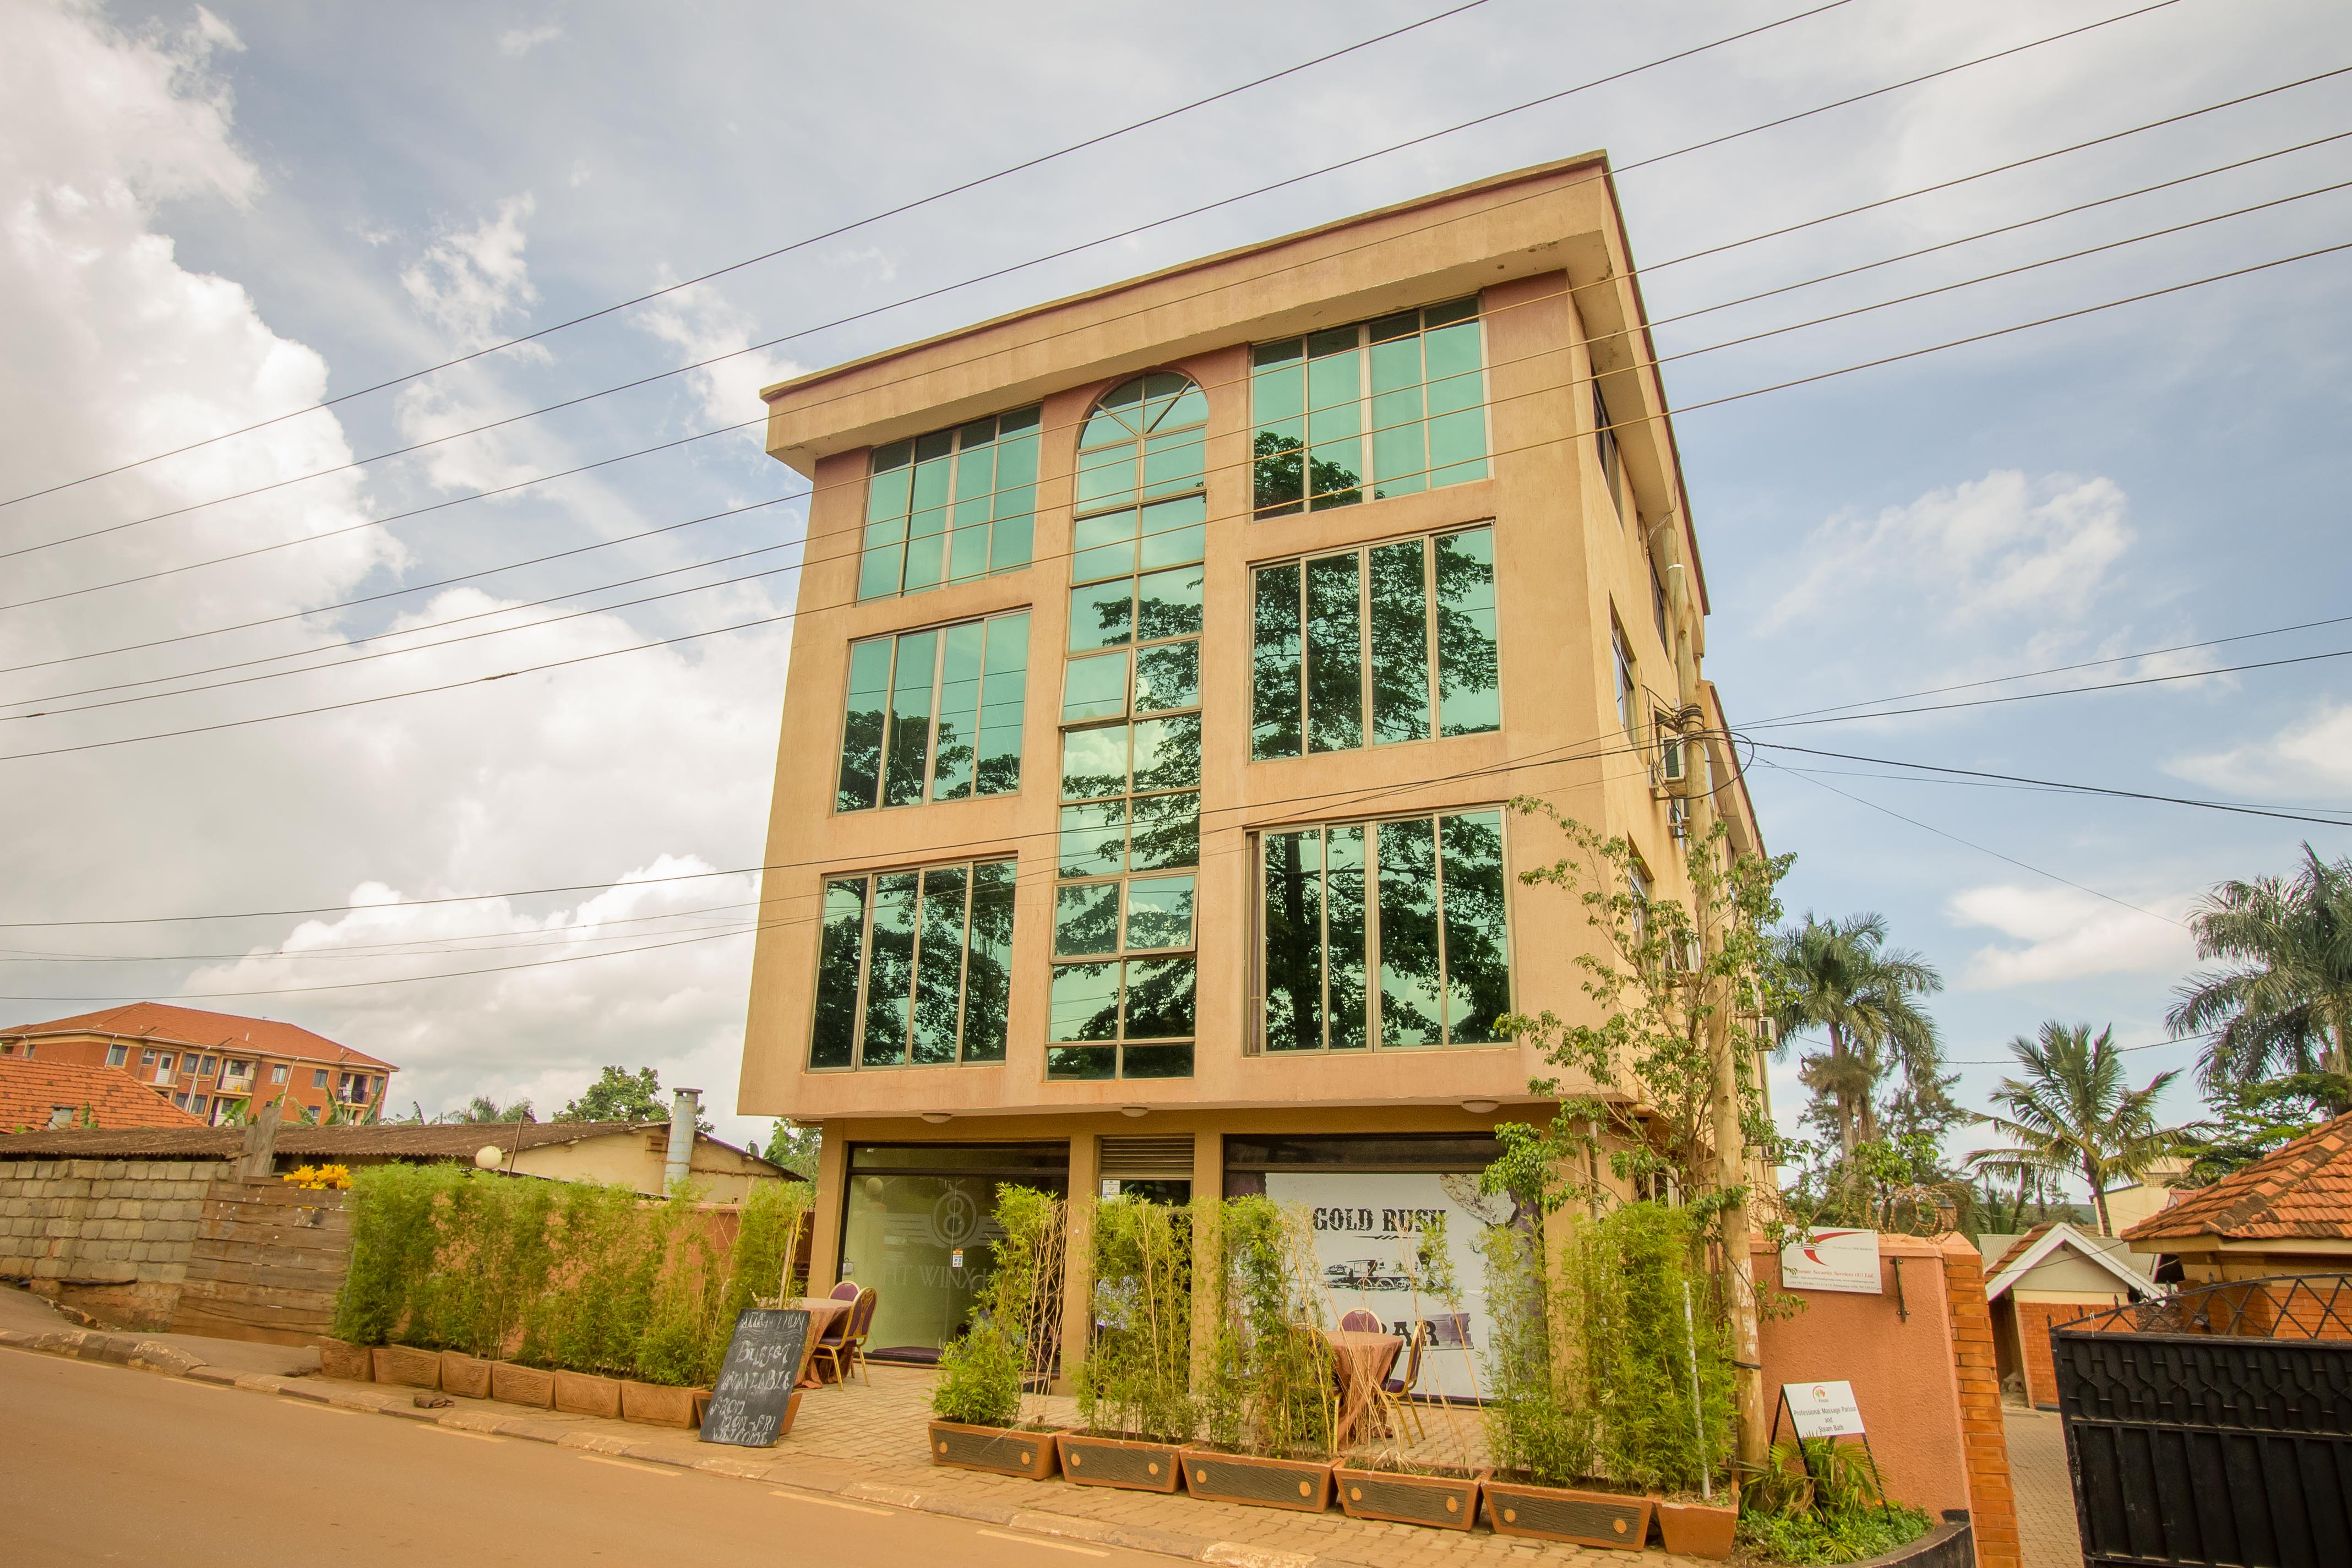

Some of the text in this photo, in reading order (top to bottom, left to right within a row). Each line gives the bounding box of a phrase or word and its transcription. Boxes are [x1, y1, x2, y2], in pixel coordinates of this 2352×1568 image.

[1313, 1207, 1447, 1233] GOLD RUSH
[1381, 1320, 1439, 1347] AR
